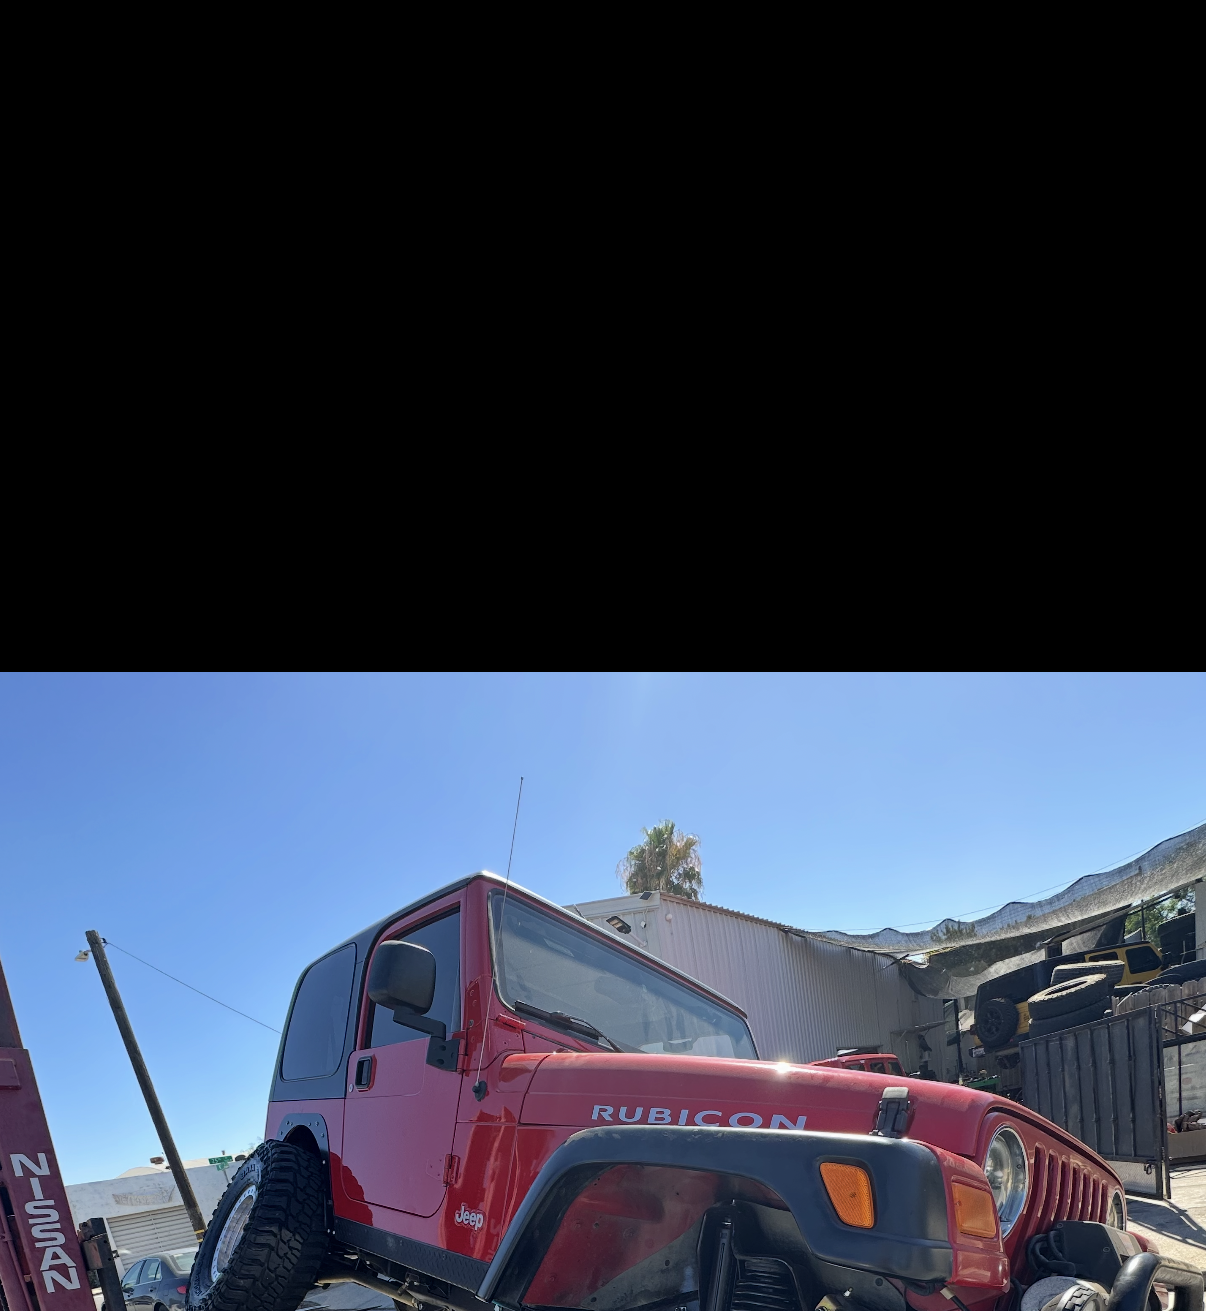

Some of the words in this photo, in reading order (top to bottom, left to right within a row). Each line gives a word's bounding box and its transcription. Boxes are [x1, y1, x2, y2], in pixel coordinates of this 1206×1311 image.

[591, 1105, 807, 1130] RUBICON
[9, 1152, 80, 1293] NISSAN
[456, 1204, 483, 1230] Jeep
